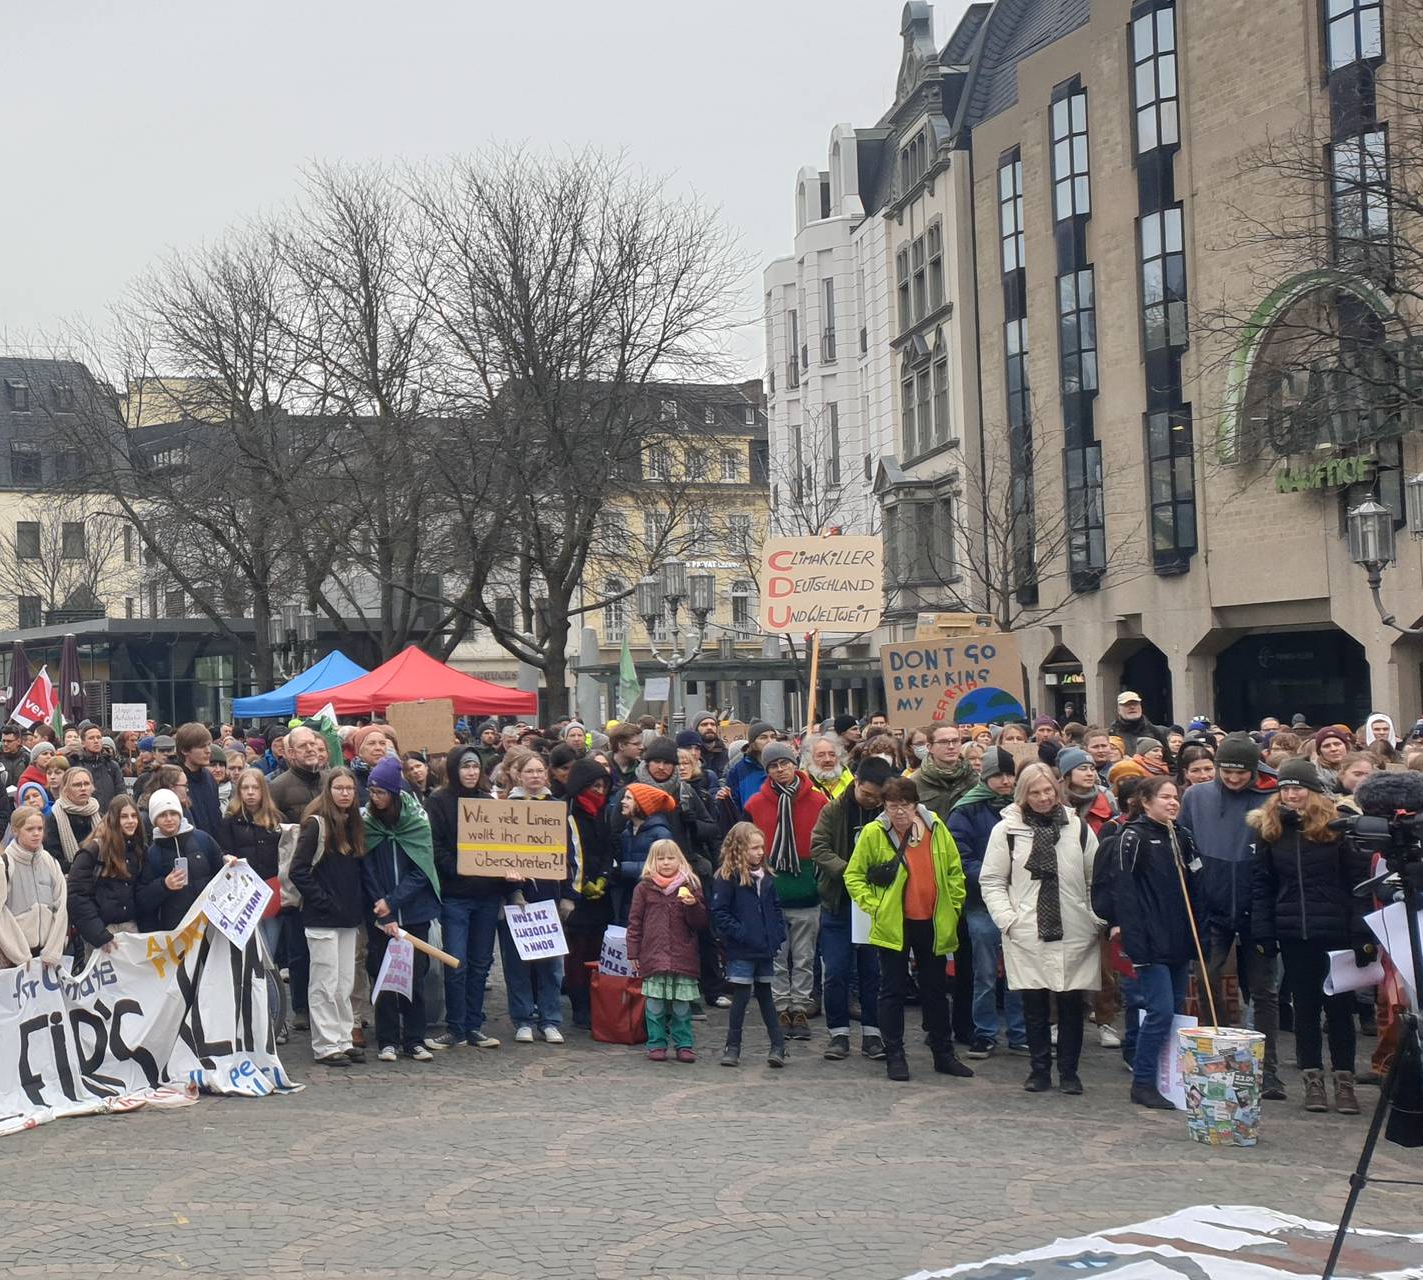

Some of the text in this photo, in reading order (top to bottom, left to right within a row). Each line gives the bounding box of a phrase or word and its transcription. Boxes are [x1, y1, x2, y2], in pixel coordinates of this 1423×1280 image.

[890, 644, 996, 672] DON'T GO
[893, 669, 991, 692] BREAKING
[897, 697, 924, 712] MY
[933, 680, 978, 721] EARTH
[463, 805, 561, 826] Wie viele Linien
[468, 827, 552, 844] wollt ihr noch
[534, 910, 548, 920] IN
[235, 917, 247, 935] IN
[514, 923, 558, 938] STUDENTS
[608, 947, 622, 960] IN
